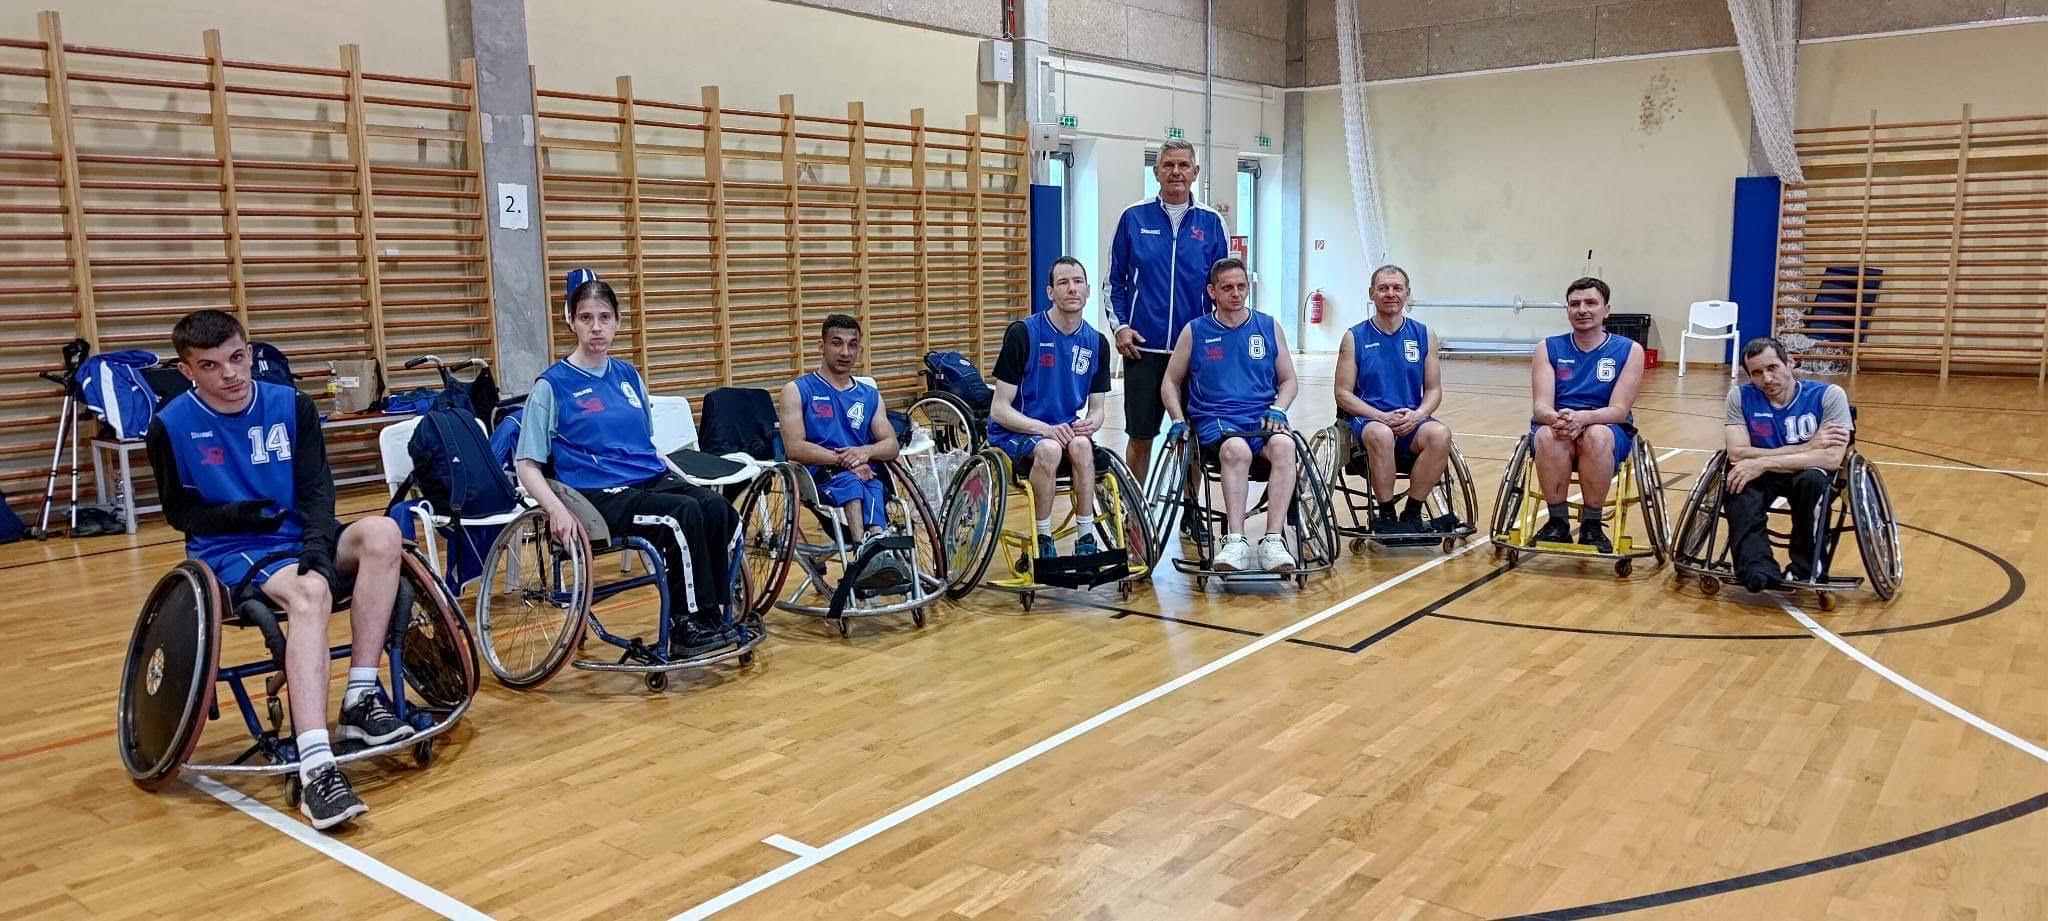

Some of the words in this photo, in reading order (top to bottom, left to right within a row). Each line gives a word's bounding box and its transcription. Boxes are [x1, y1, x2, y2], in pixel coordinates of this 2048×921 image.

[505, 195, 521, 213] 2.
[1071, 344, 1093, 376] 15
[1248, 334, 1266, 360] 8
[1403, 339, 1420, 363] 5
[1596, 357, 1616, 382] 6
[620, 381, 642, 409] 9
[846, 401, 865, 430] 4
[1784, 412, 1818, 444] 10
[247, 422, 292, 465] 14
